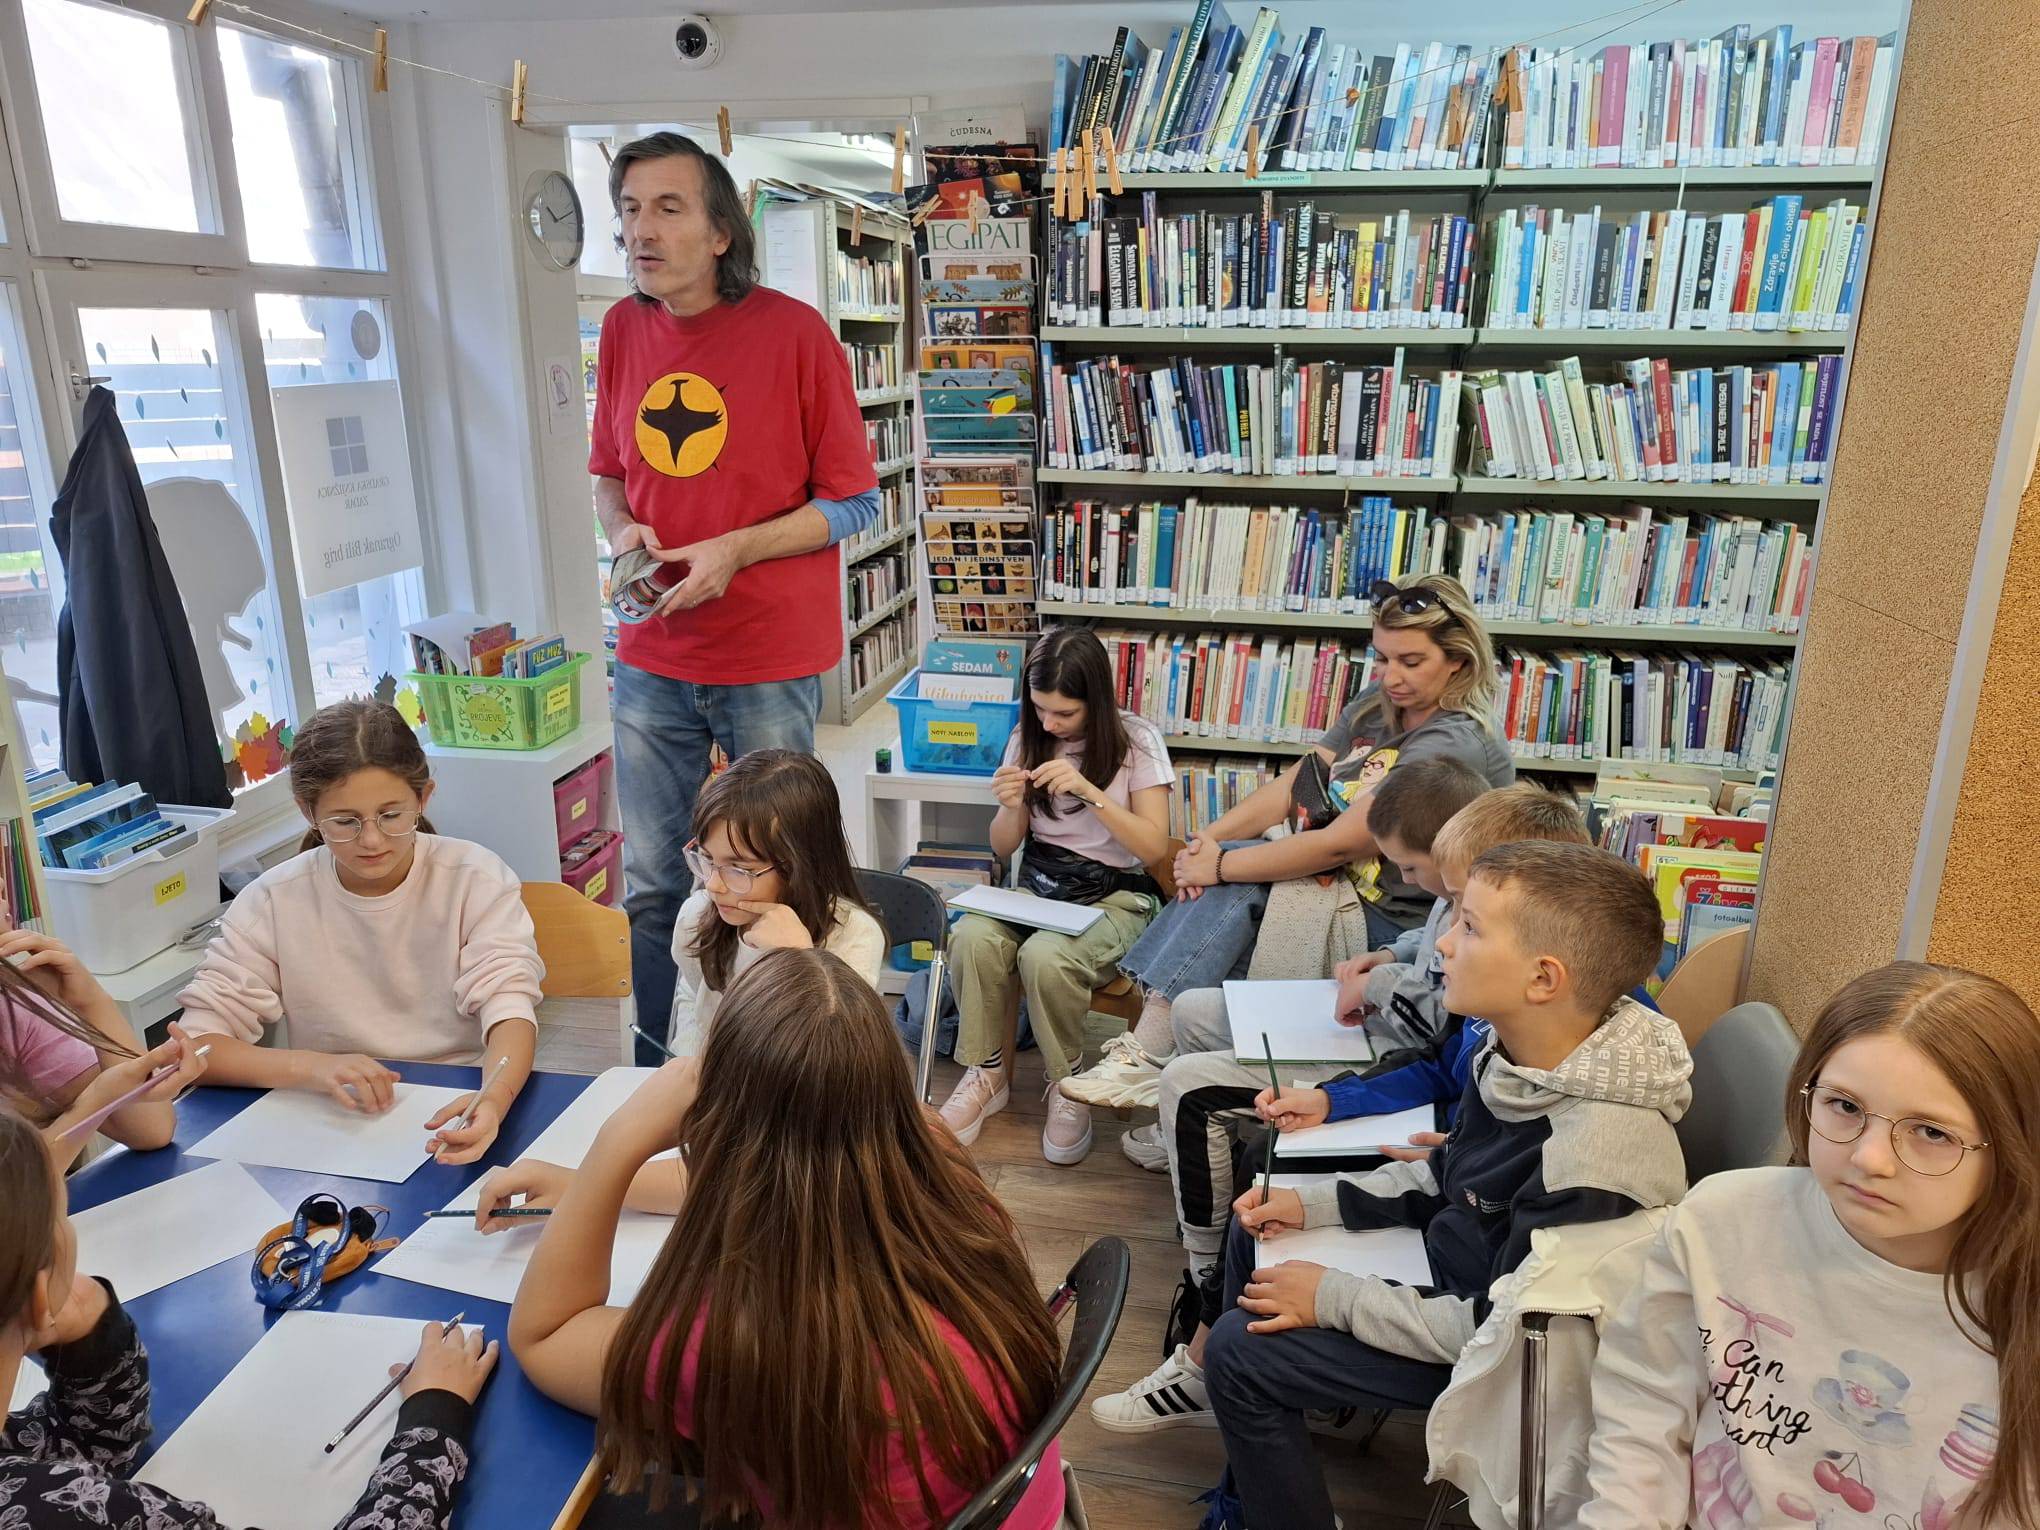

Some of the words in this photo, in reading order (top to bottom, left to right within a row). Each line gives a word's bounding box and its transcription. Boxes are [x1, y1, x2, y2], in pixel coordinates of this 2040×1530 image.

[1108, 44, 1123, 76] PARKOVI
[950, 126, 993, 137] ČUDESNA
[1298, 205, 1311, 247] KOZMOS
[1441, 217, 1452, 245] JAMES
[1784, 201, 1799, 232] obitelj
[931, 222, 1028, 251] EGIPAT
[1780, 233, 1792, 259] cijelu
[1108, 245, 1122, 287] ELEGANTNI
[1126, 244, 1137, 279] SKRIVENA
[1296, 251, 1308, 282] SAGAN
[1315, 242, 1326, 273] PRASAK
[1741, 250, 1754, 275] SRCE
[1778, 261, 1786, 273] za
[1314, 274, 1325, 297] VELIKI
[1764, 253, 1780, 292] Zdravlje
[1109, 288, 1122, 310] SVEM
[1127, 279, 1137, 309] STVARNO
[1294, 282, 1306, 306] CARL
[1326, 427, 1337, 455] JUDSKA
[1564, 433, 1576, 463] PRIROD
[933, 555, 961, 563] JEDAN
[1551, 522, 1569, 577] Nutricionizam
[951, 662, 993, 674] SEDAM
[161, 880, 181, 896] LJETO
[1713, 913, 1752, 924] fotoalbu
[1723, 1339, 1785, 1383] Can
[1713, 1370, 1812, 1444] thing
